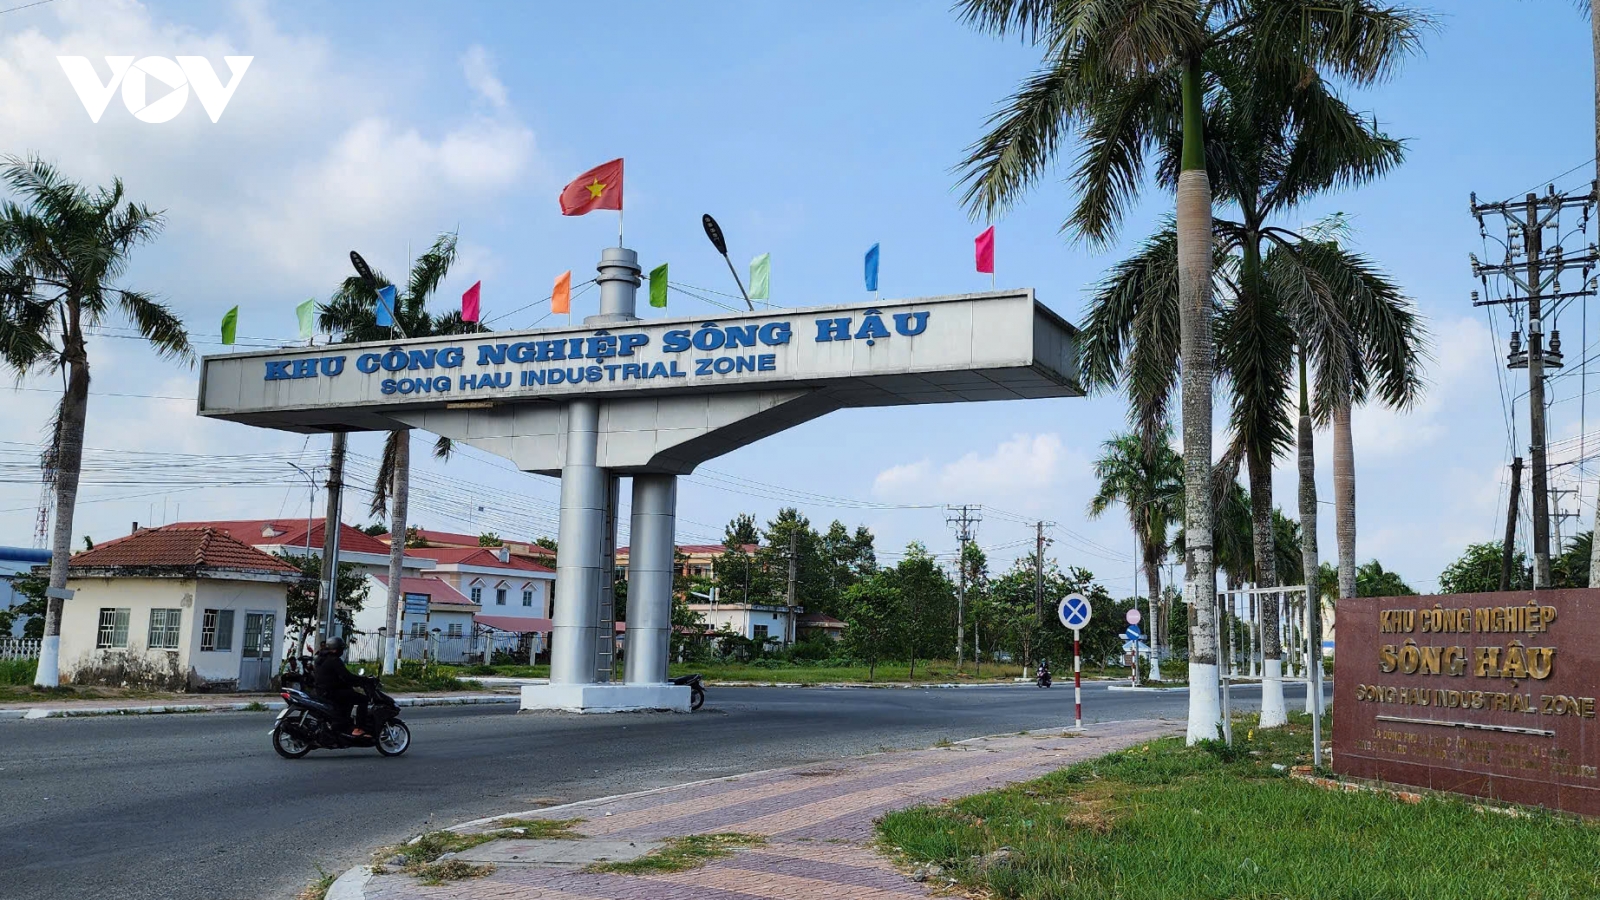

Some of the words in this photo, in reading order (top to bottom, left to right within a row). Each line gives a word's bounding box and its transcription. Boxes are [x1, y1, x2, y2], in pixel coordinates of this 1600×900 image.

[264, 355, 346, 381] KHU
[355, 345, 465, 374] CÔNG
[476, 329, 649, 364] NGHIỆP
[662, 321, 793, 353] SÔNG
[814, 308, 930, 346] HẬU
[380, 375, 451, 395] SONG
[459, 371, 512, 390] HAU
[520, 361, 686, 387] INDUSTRIAL
[695, 353, 776, 377] ZONE
[1379, 609, 1416, 634] KHU
[1419, 603, 1472, 634] CÔNG
[1475, 599, 1557, 638] NGHIỆP
[1379, 637, 1468, 677] SÔNG
[1473, 639, 1558, 688] HẬU
[1356, 684, 1397, 703] SONG
[1400, 686, 1431, 706] HAU
[1434, 689, 1537, 713] INDUSTRIAL
[1540, 694, 1596, 718] ZONE
